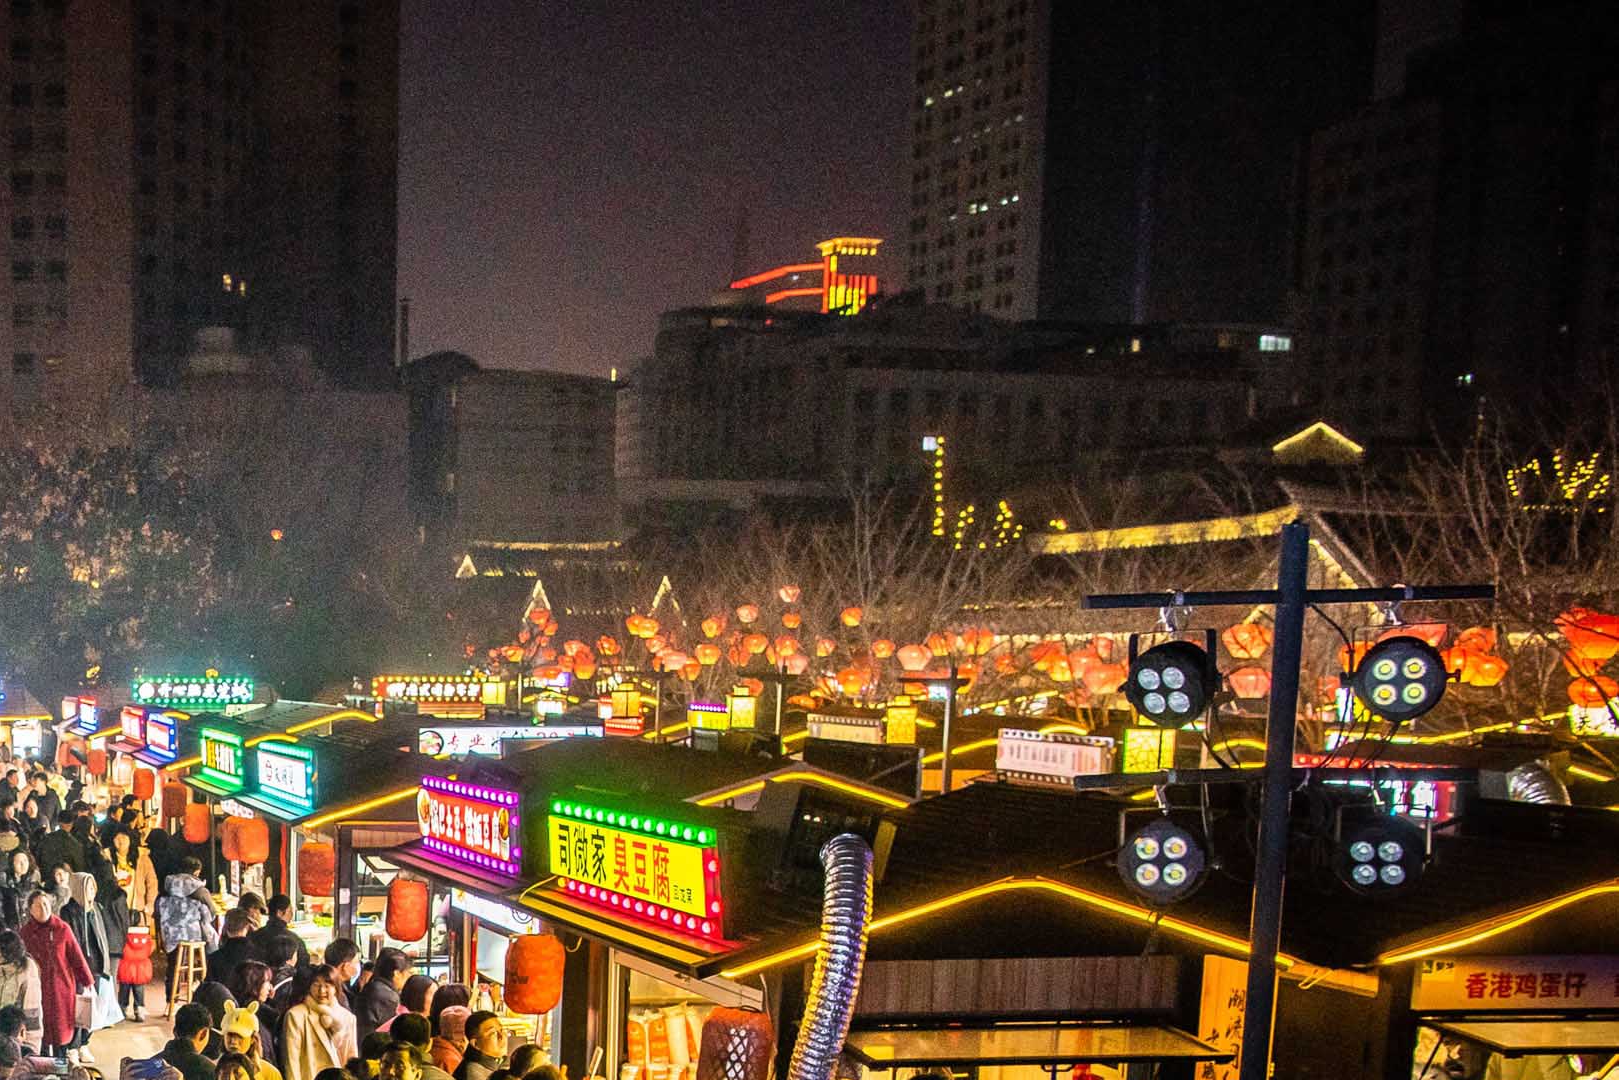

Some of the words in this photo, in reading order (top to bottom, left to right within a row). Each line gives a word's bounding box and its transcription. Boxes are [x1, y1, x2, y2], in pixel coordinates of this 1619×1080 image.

[1465, 972, 1586, 999] 香港鸡蛋仔
